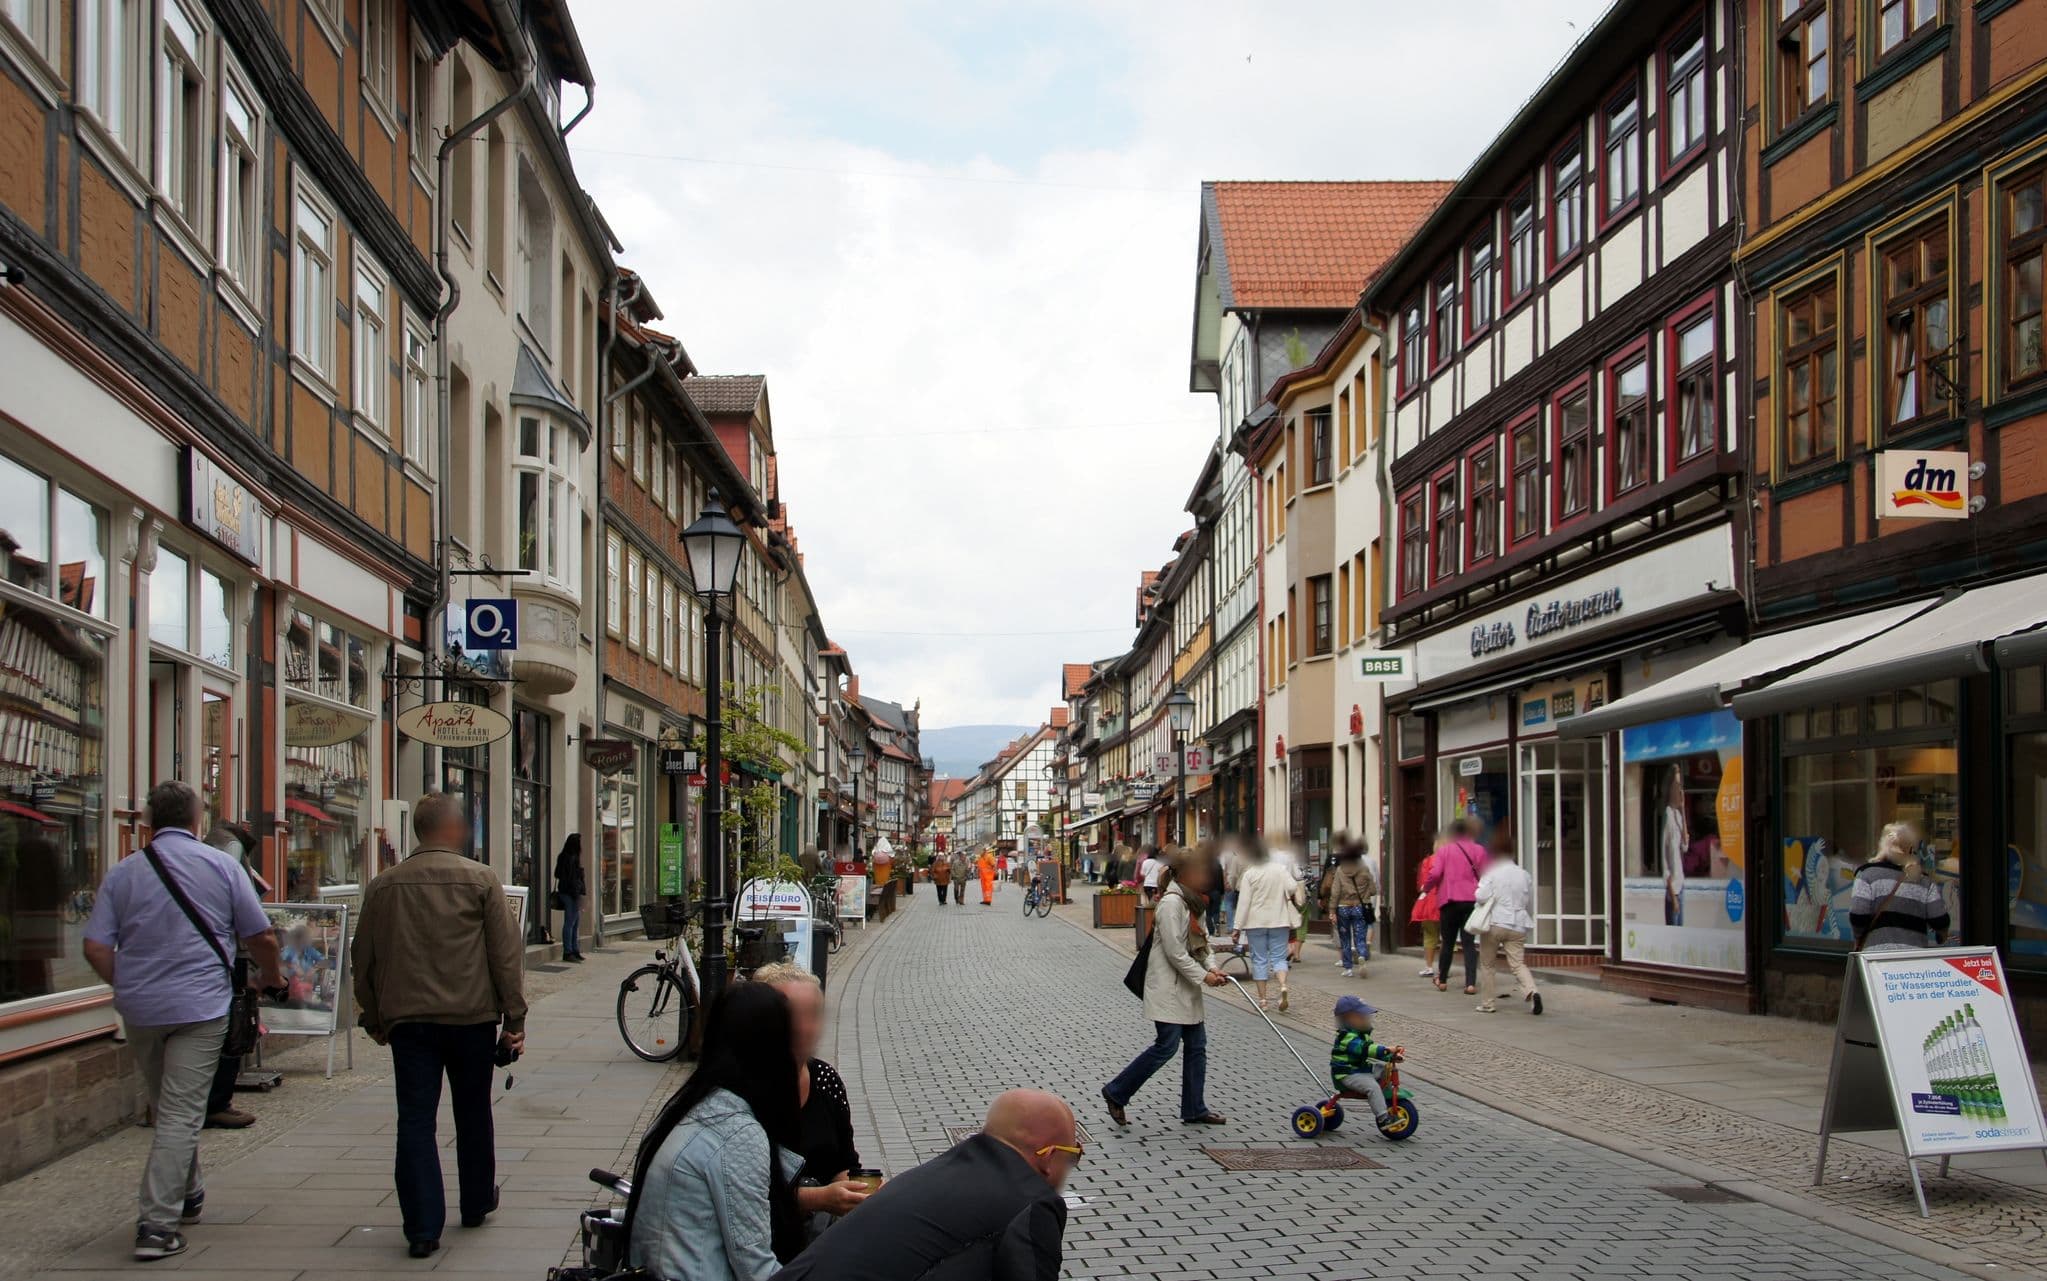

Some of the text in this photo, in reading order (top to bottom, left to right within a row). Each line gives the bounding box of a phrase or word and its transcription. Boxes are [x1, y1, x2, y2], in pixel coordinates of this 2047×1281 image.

[1904, 459, 1956, 491] dm
[1365, 661, 1399, 672] BASE
[1553, 696, 1574, 715] BASE
[416, 704, 475, 736] Apart
[437, 727, 459, 736] HOTEL
[467, 728, 490, 736] GARNI
[1963, 958, 1992, 967] Jetzt bei
[1882, 970, 1952, 981] Tauschzylinder
[1885, 979, 1972, 991] für Wassersprudler
[1916, 991, 1928, 999] an
[1930, 990, 1946, 998] der
[1948, 988, 1980, 997] Kasse!
[1975, 1127, 2031, 1139] sodastream
